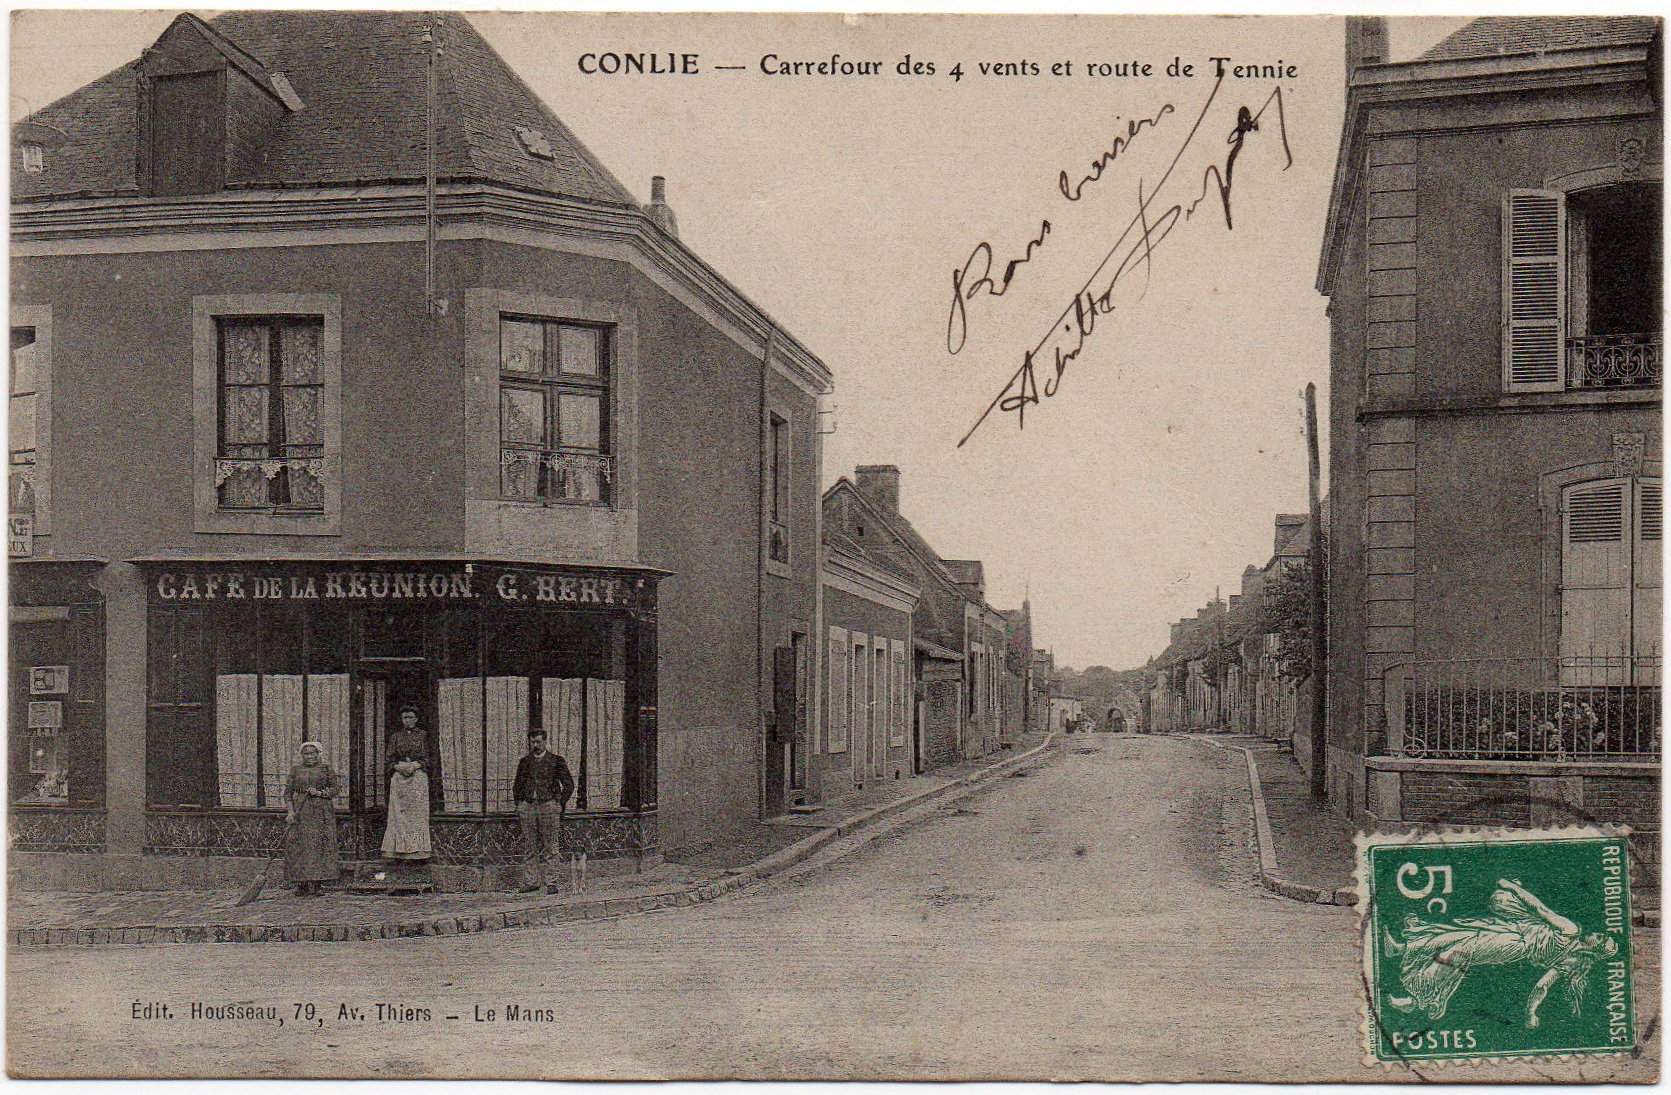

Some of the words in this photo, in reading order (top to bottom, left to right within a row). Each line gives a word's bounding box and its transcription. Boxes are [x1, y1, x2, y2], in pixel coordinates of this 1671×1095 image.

[252, 576, 283, 600] DE
[289, 576, 319, 600] LA
[495, 573, 529, 602] G.
[1602, 844, 1624, 935] REPUBLIQUE
[1605, 960, 1629, 1044] FRANÇAISE
[1392, 1029, 1478, 1050] POSTES
